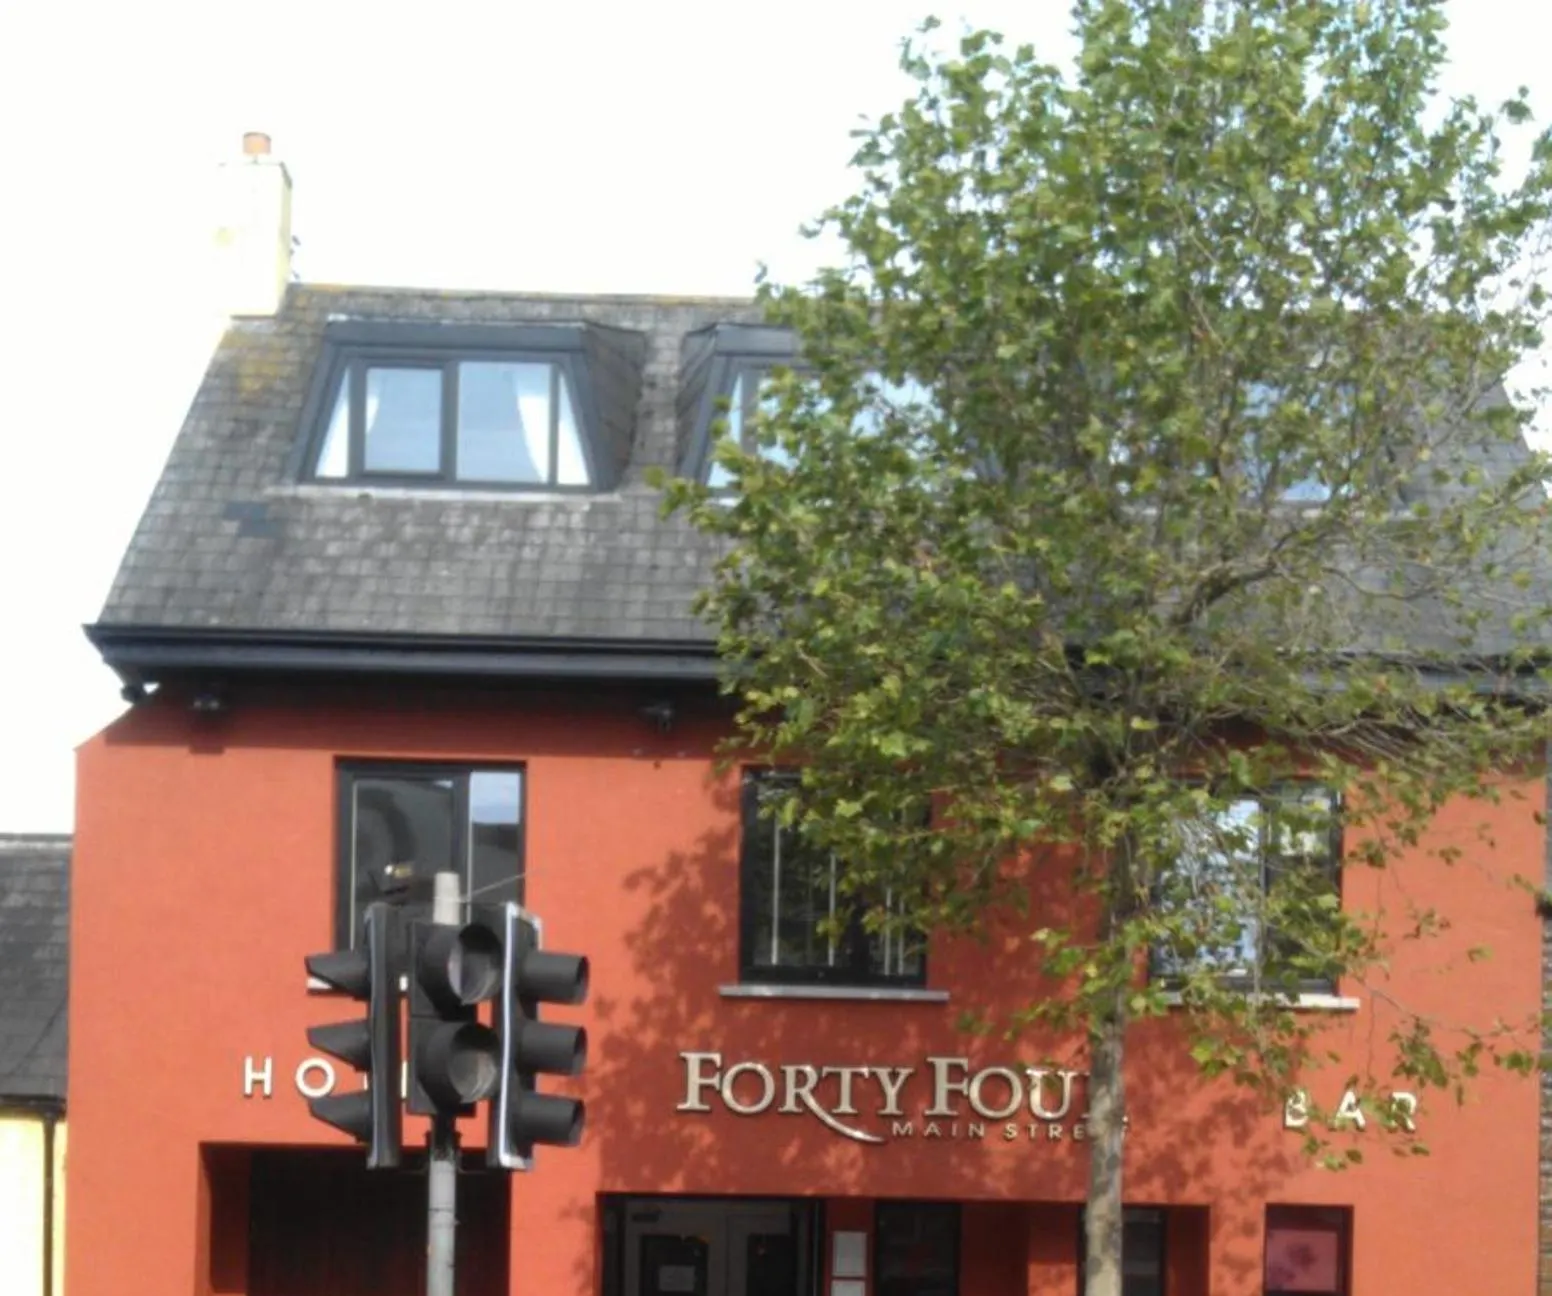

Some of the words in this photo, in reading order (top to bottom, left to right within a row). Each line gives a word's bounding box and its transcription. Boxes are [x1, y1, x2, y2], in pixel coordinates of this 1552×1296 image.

[676, 1051, 914, 1142] FORTY
[924, 1055, 1128, 1122] FOU
[1285, 1089, 1417, 1130] BAR
[892, 1121, 986, 1136] MAIN
[1005, 1123, 1128, 1139] STRE
